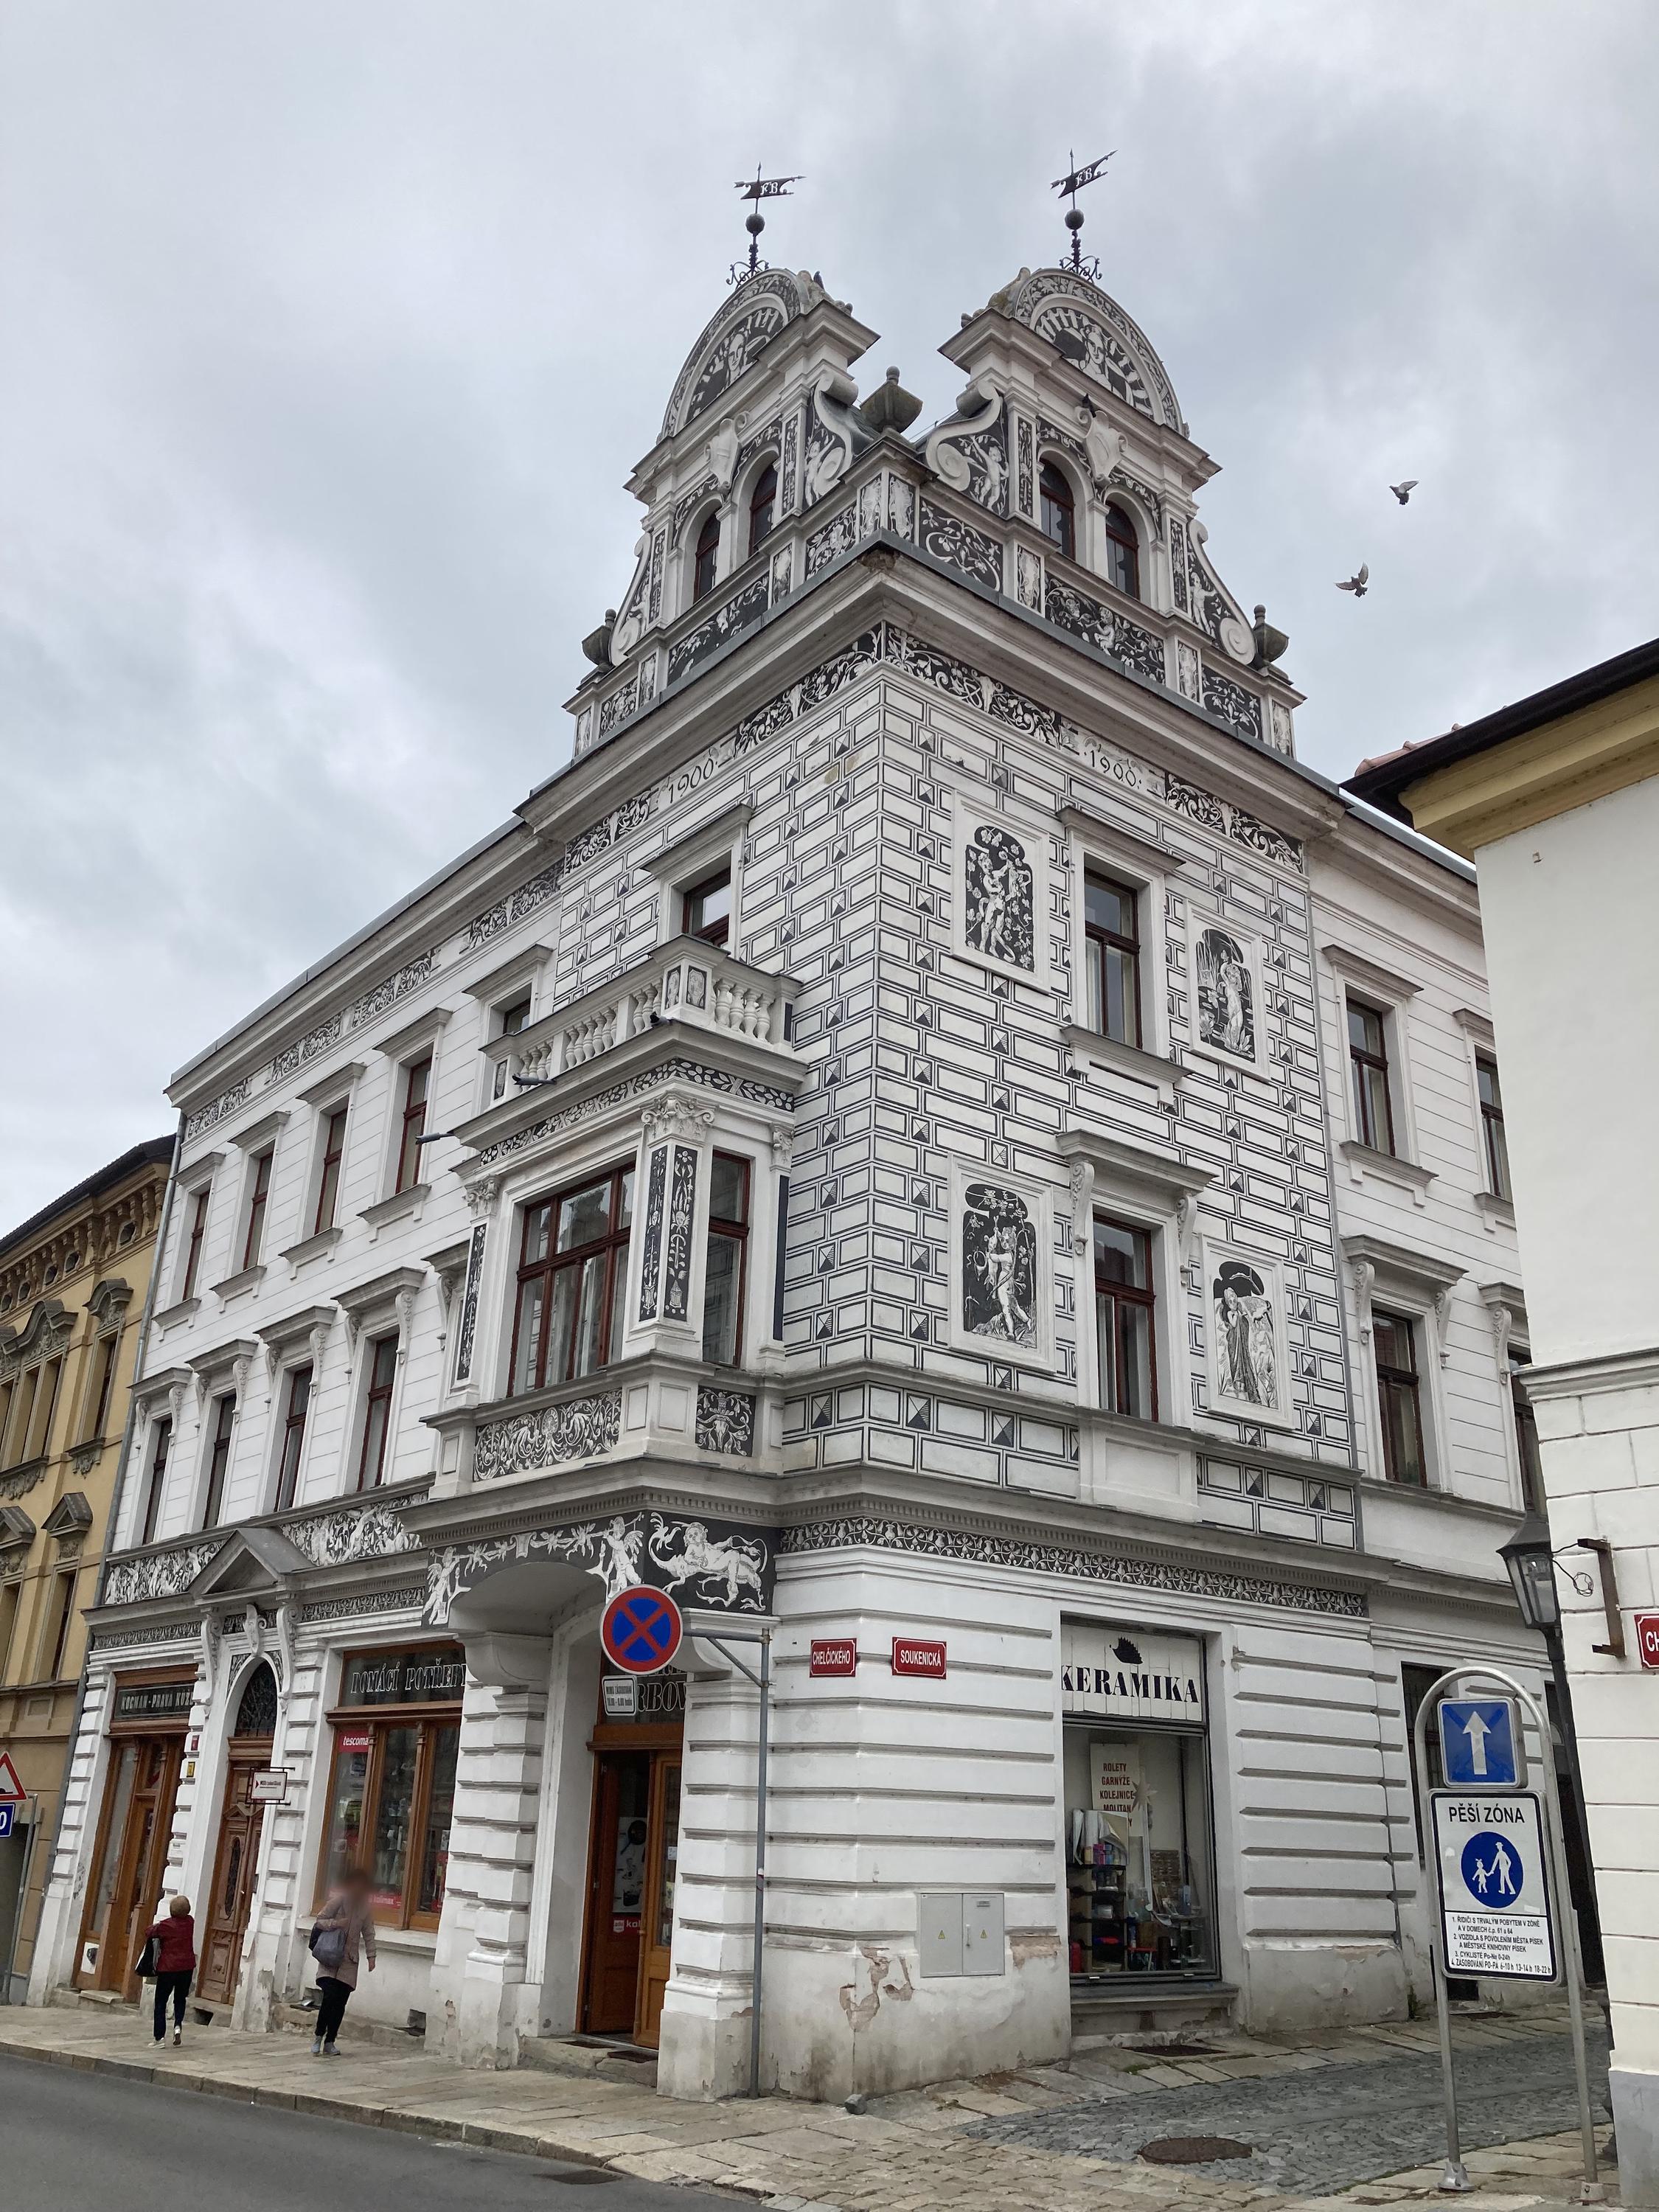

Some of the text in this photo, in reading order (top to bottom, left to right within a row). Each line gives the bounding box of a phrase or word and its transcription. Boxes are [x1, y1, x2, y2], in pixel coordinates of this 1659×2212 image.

[813, 1646, 851, 1666] CHELČICKÉHO
[900, 1649, 942, 1667] SOUKENICKÁ
[350, 1660, 400, 1694] DOMÁCÍ
[1062, 1665, 1200, 1703] KERAMIKA
[343, 1736, 369, 1746] tescoma
[1103, 1763, 1127, 1772] ROLETY
[1099, 1790, 1135, 1800] KOLEJNICE
[1449, 1803, 1525, 1823] PĚŠÍ ZÓNA
[1499, 1919, 1523, 1927] POBYTEM
